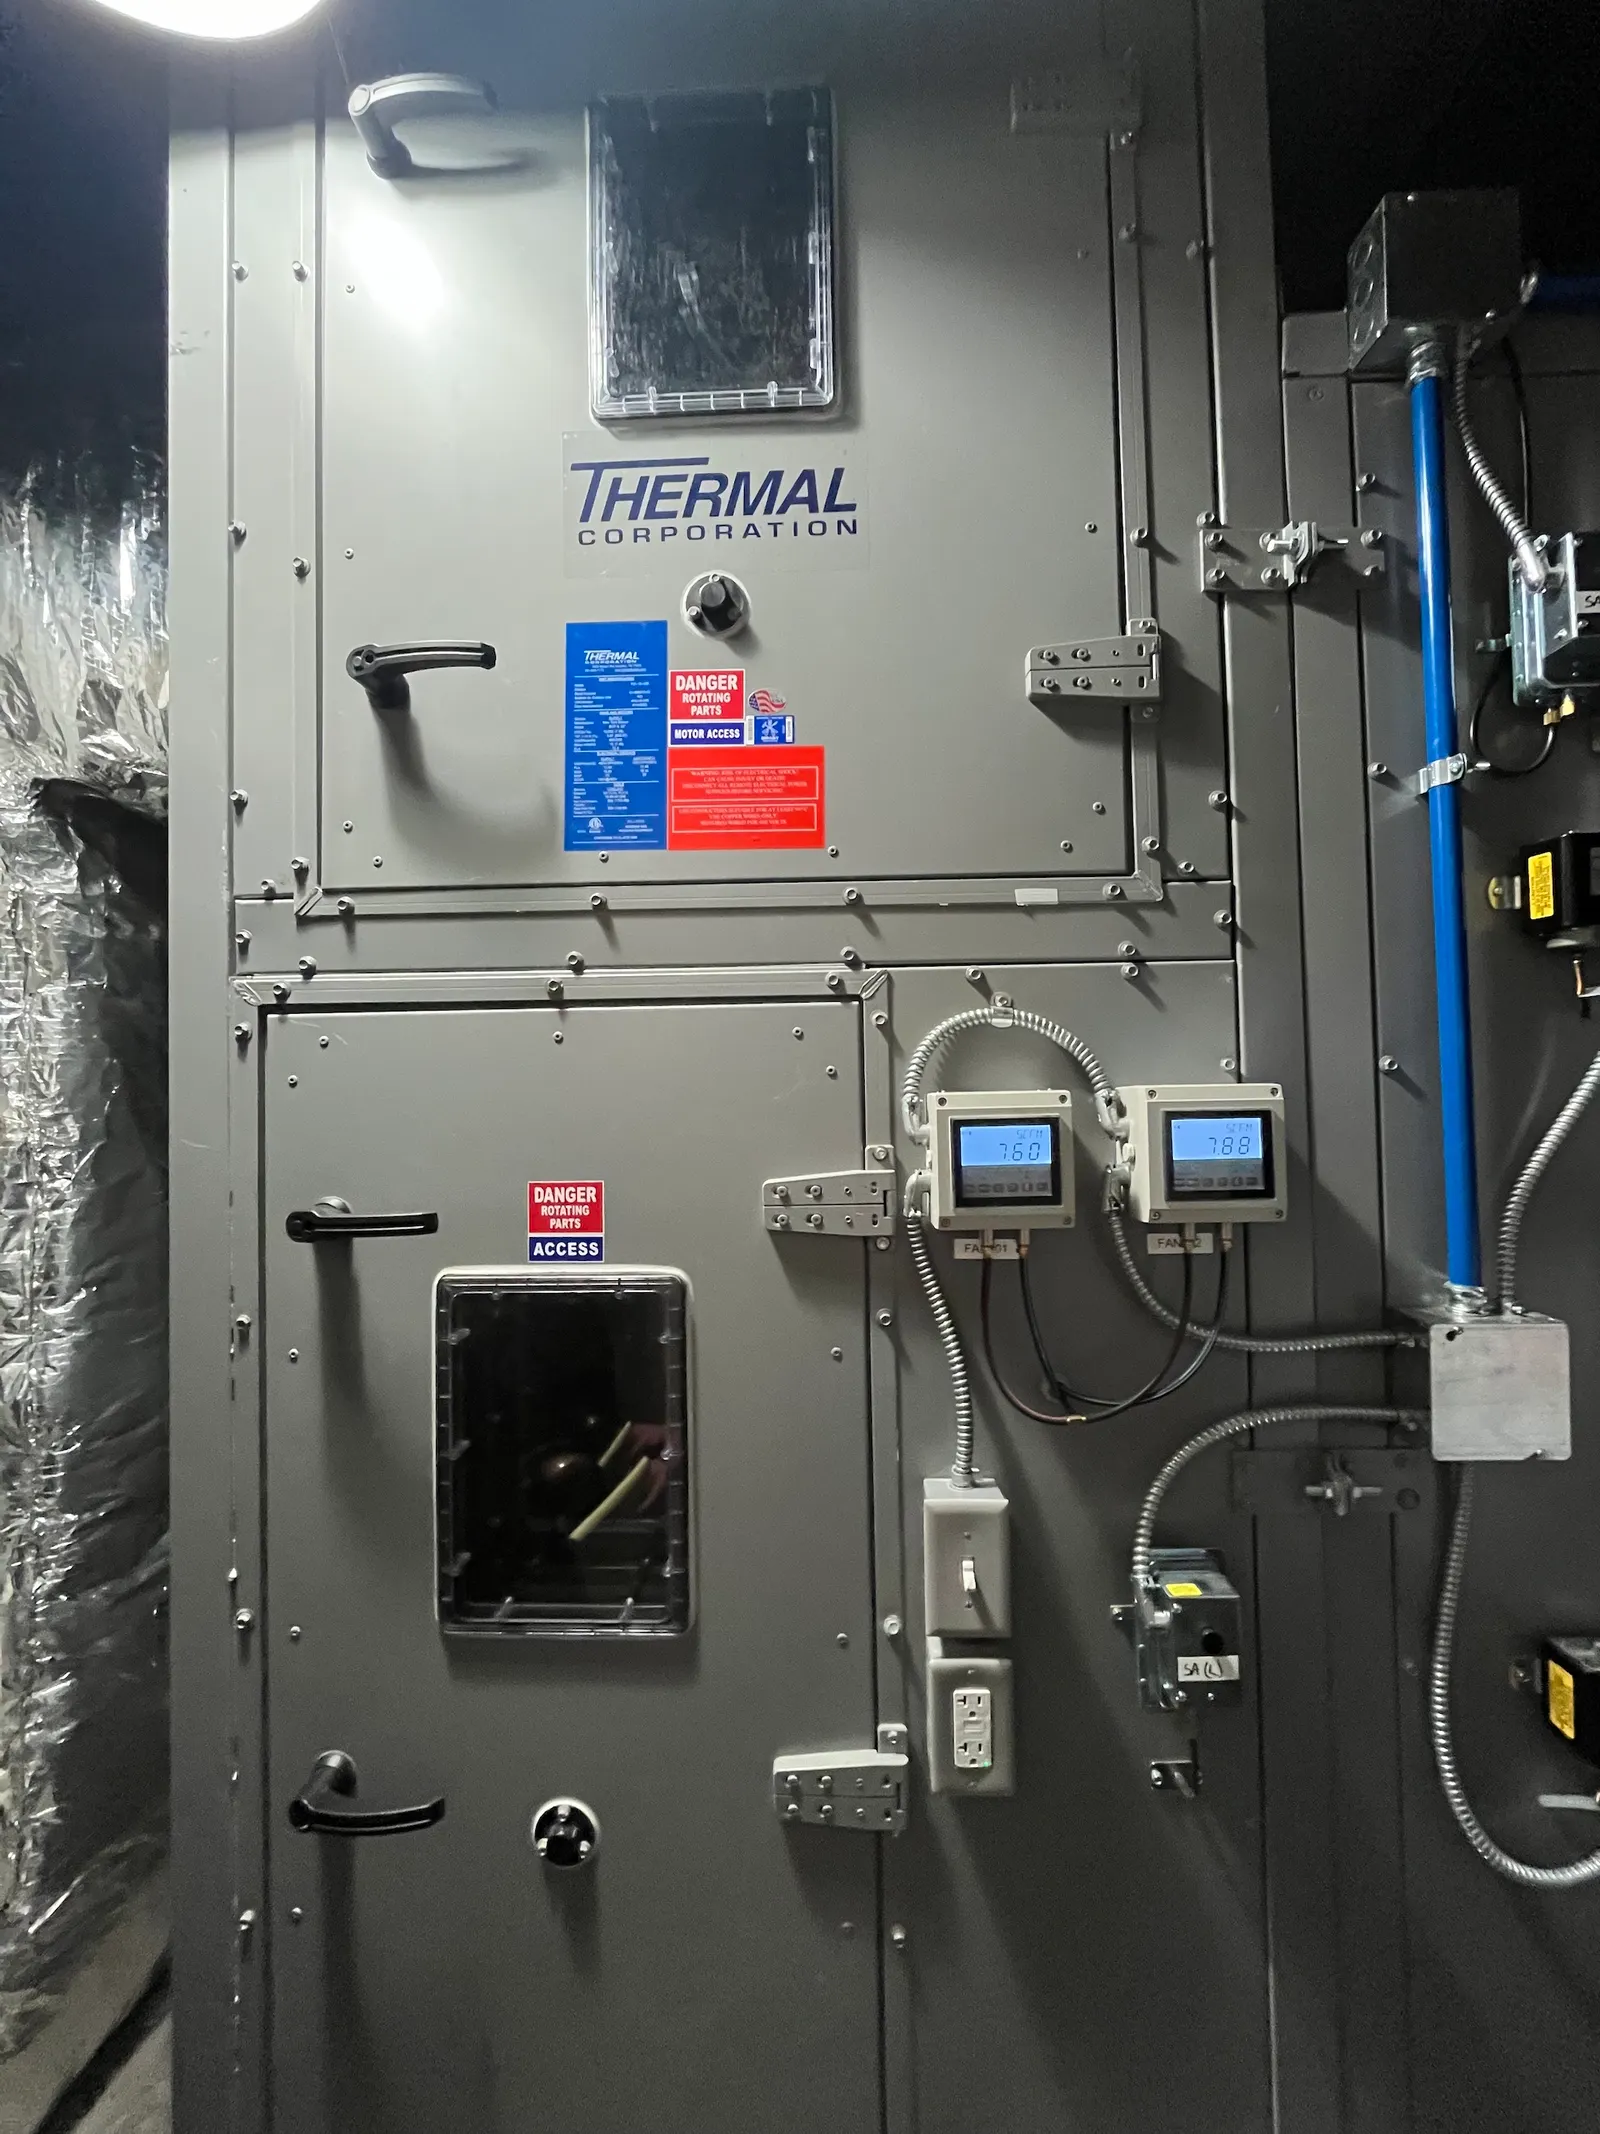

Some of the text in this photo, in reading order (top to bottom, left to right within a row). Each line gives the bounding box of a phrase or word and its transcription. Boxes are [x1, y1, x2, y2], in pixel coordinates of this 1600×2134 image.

[570, 457, 857, 523] THERMAL
[578, 519, 857, 545] CORPORATION
[584, 650, 640, 660] THERMAL
[675, 674, 738, 691] DANGER
[682, 692, 731, 703] ROTATING
[690, 705, 722, 716] PARTS
[674, 729, 704, 739] MOTOR
[707, 728, 740, 739] ACCESS
[534, 1186, 597, 1203] DANGER
[541, 1205, 590, 1216] ROTATING
[549, 1218, 581, 1229] PARTS
[533, 1242, 599, 1256] ACCESS
[1184, 1661, 1223, 1679] SA (L)
